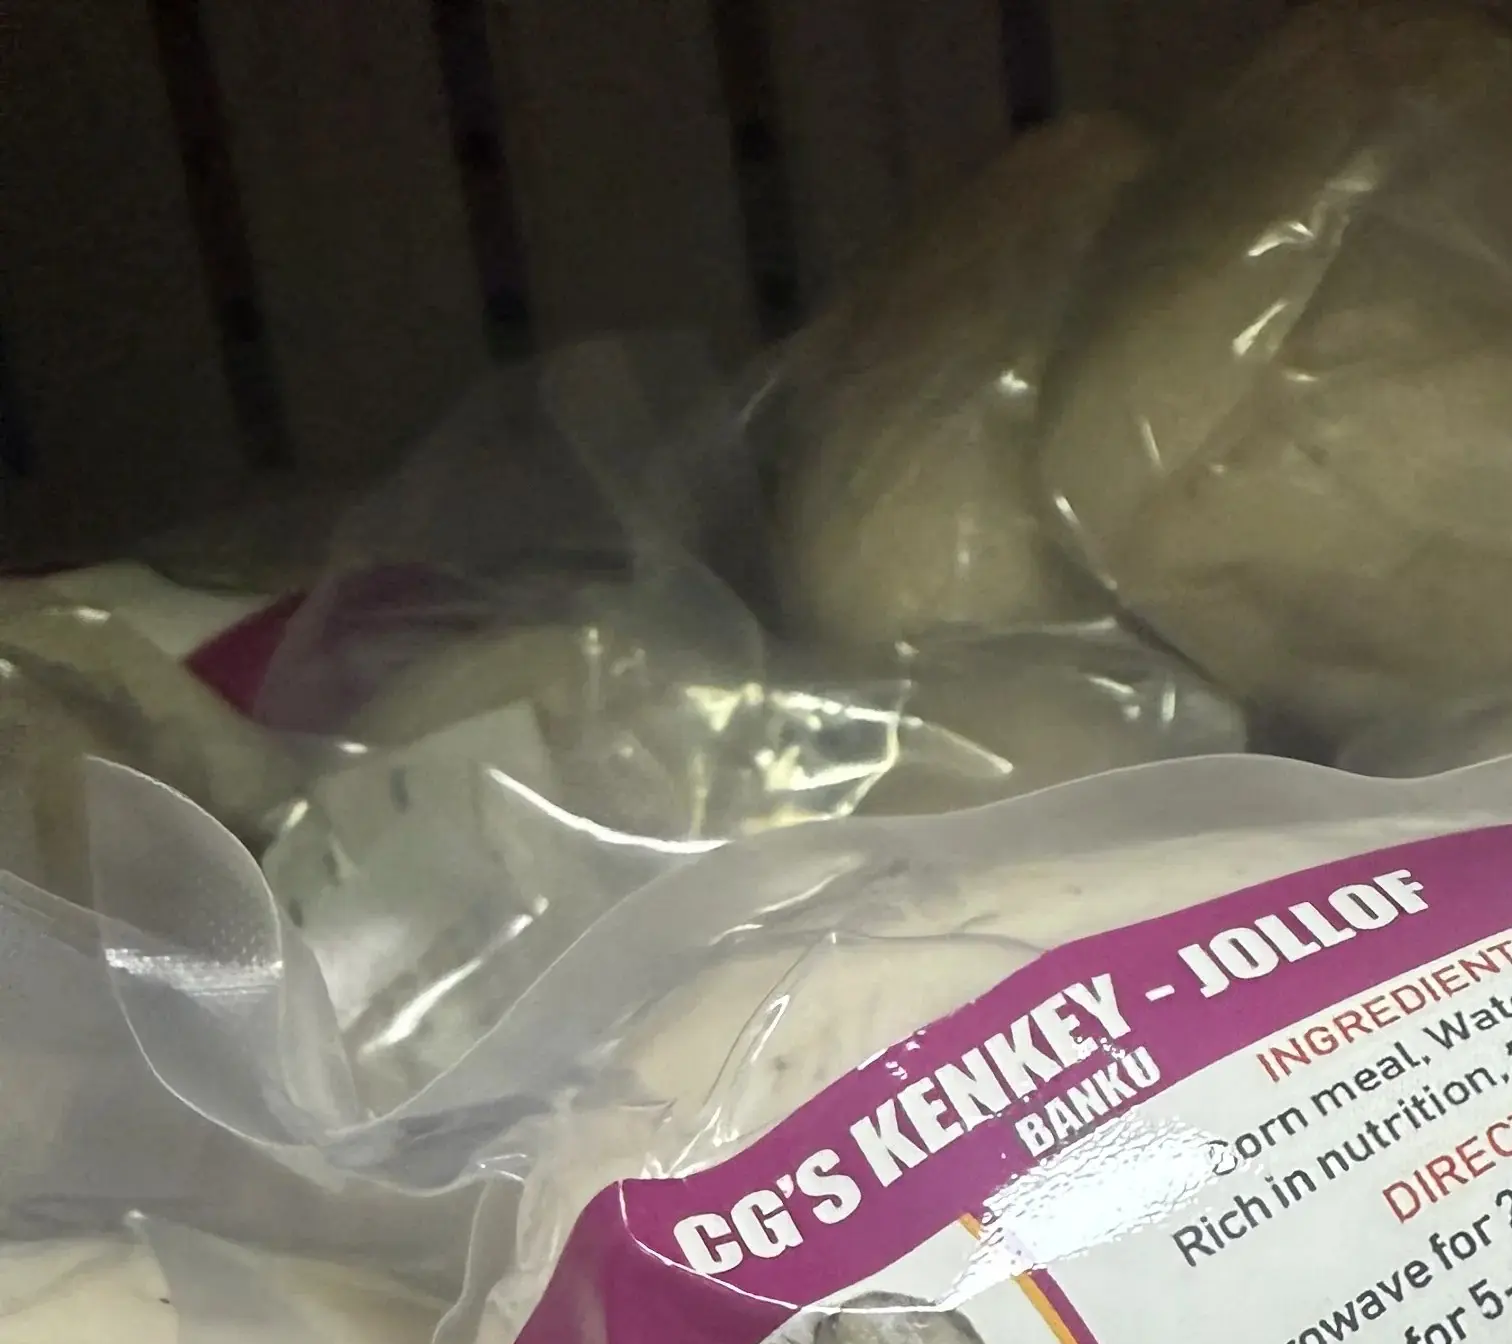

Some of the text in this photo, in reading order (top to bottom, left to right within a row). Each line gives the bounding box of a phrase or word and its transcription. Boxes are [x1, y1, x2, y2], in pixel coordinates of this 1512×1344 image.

[673, 1149, 862, 1275] CG'S
[850, 973, 1132, 1188] KENKEY
[1178, 869, 1429, 998] JOLLOF
[1015, 1046, 1160, 1157] BANKU
[1172, 1195, 1273, 1267] Rich
[1265, 1170, 1317, 1208] in
[1317, 1067, 1509, 1179] nutrition,
[1429, 1214, 1491, 1270] for
